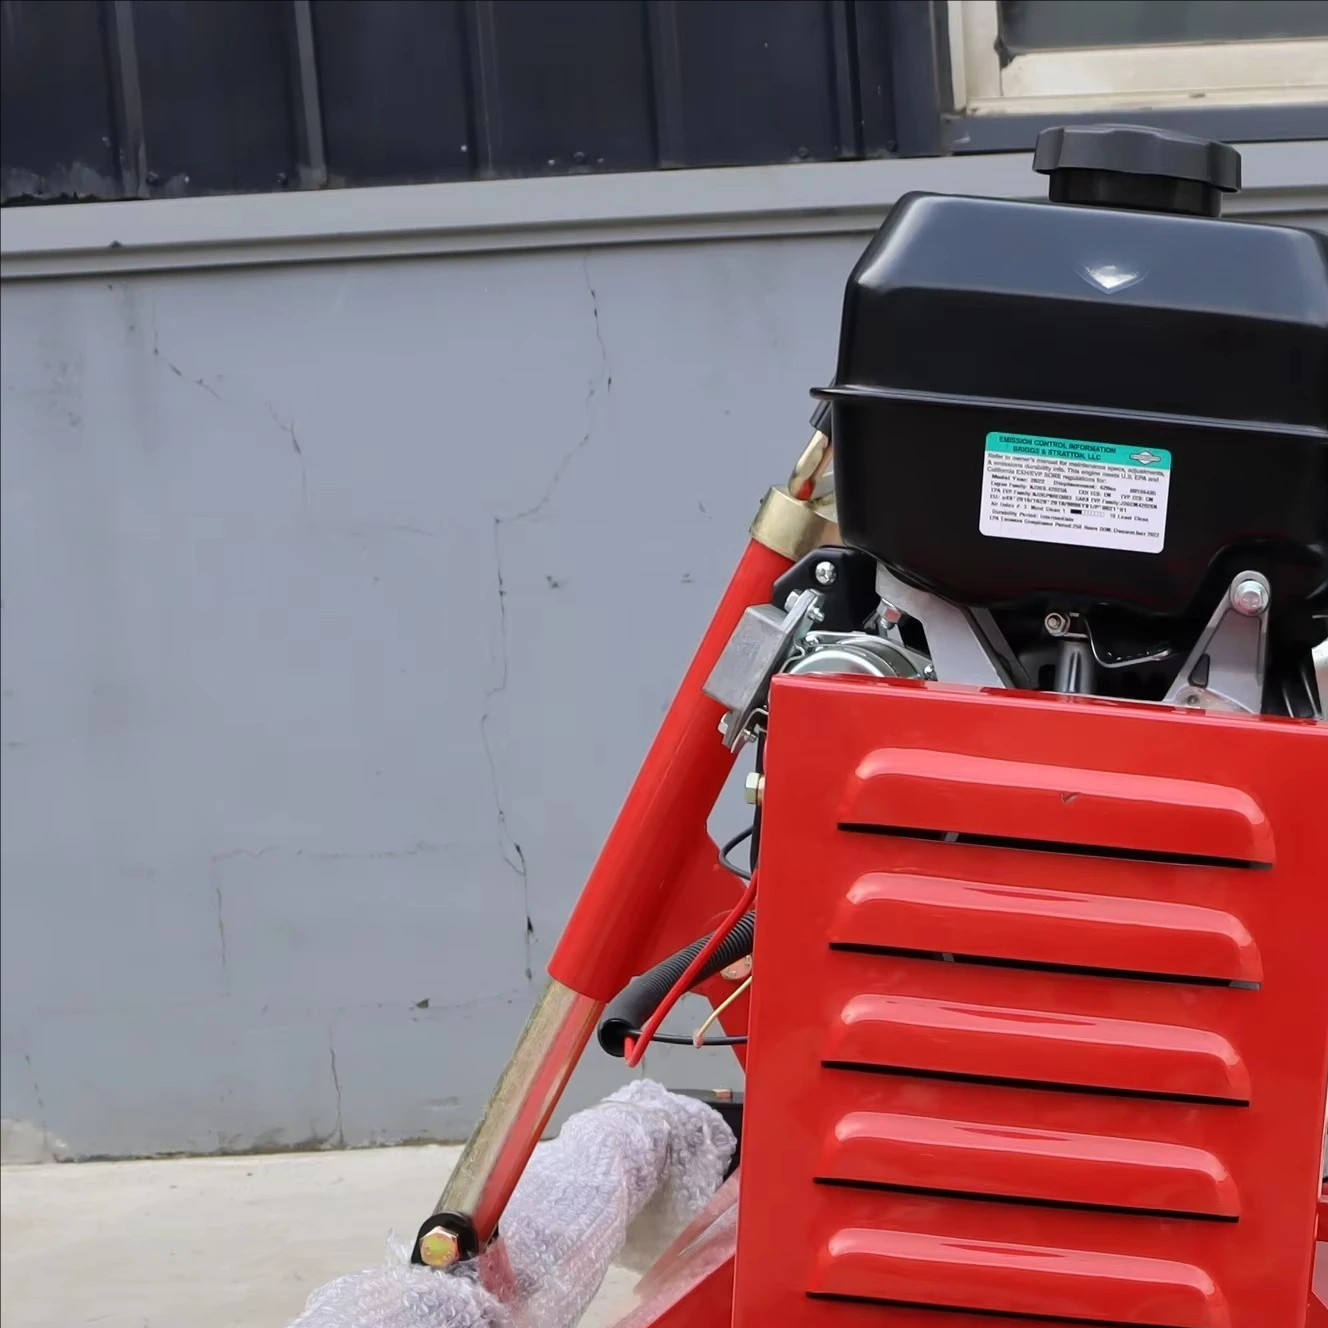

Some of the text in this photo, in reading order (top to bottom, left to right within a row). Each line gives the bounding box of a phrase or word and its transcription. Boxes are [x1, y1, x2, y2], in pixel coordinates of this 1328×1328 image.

[999, 436, 1116, 454] EMISSION CONTROL INFORMATION
[1013, 446, 1039, 454] BRIGGS
[993, 460, 1023, 468] emissions
[1068, 461, 1106, 470] maintenance
[987, 466, 1015, 474] California
[1063, 474, 1095, 482] regulations
[1040, 514, 1074, 522] Intermediate
